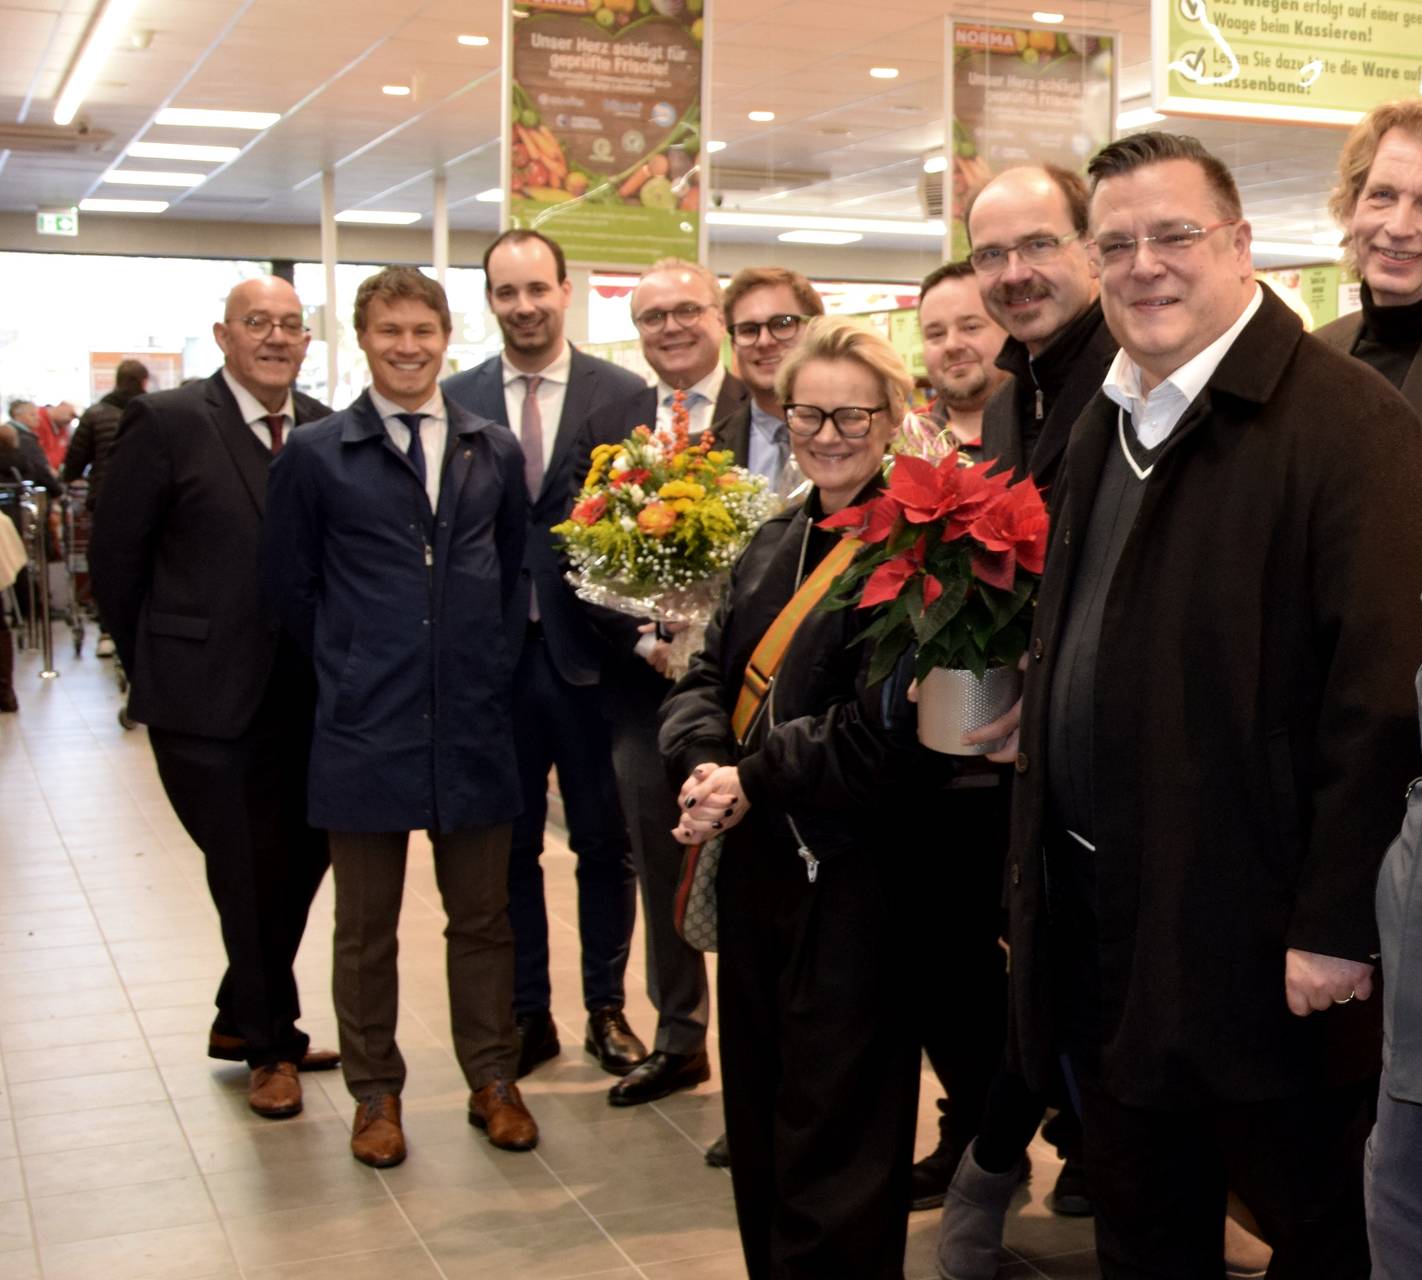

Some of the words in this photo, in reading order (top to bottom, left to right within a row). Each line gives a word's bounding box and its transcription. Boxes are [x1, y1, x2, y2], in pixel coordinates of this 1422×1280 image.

[1303, 0, 1343, 20] erfolgt
[1347, 2, 1366, 18] auf
[1370, 5, 1400, 21] einer
[1212, 12, 1257, 35] Waage
[1261, 16, 1290, 33] beim
[1294, 20, 1372, 42] Kassieren!
[531, 32, 573, 51] Unser
[577, 37, 610, 54] Herz
[955, 29, 1014, 48] NORMA
[1253, 51, 1271, 67] Sie
[1340, 58, 1358, 75] die
[1362, 61, 1400, 79] Ware
[1403, 64, 1422, 81] auf
